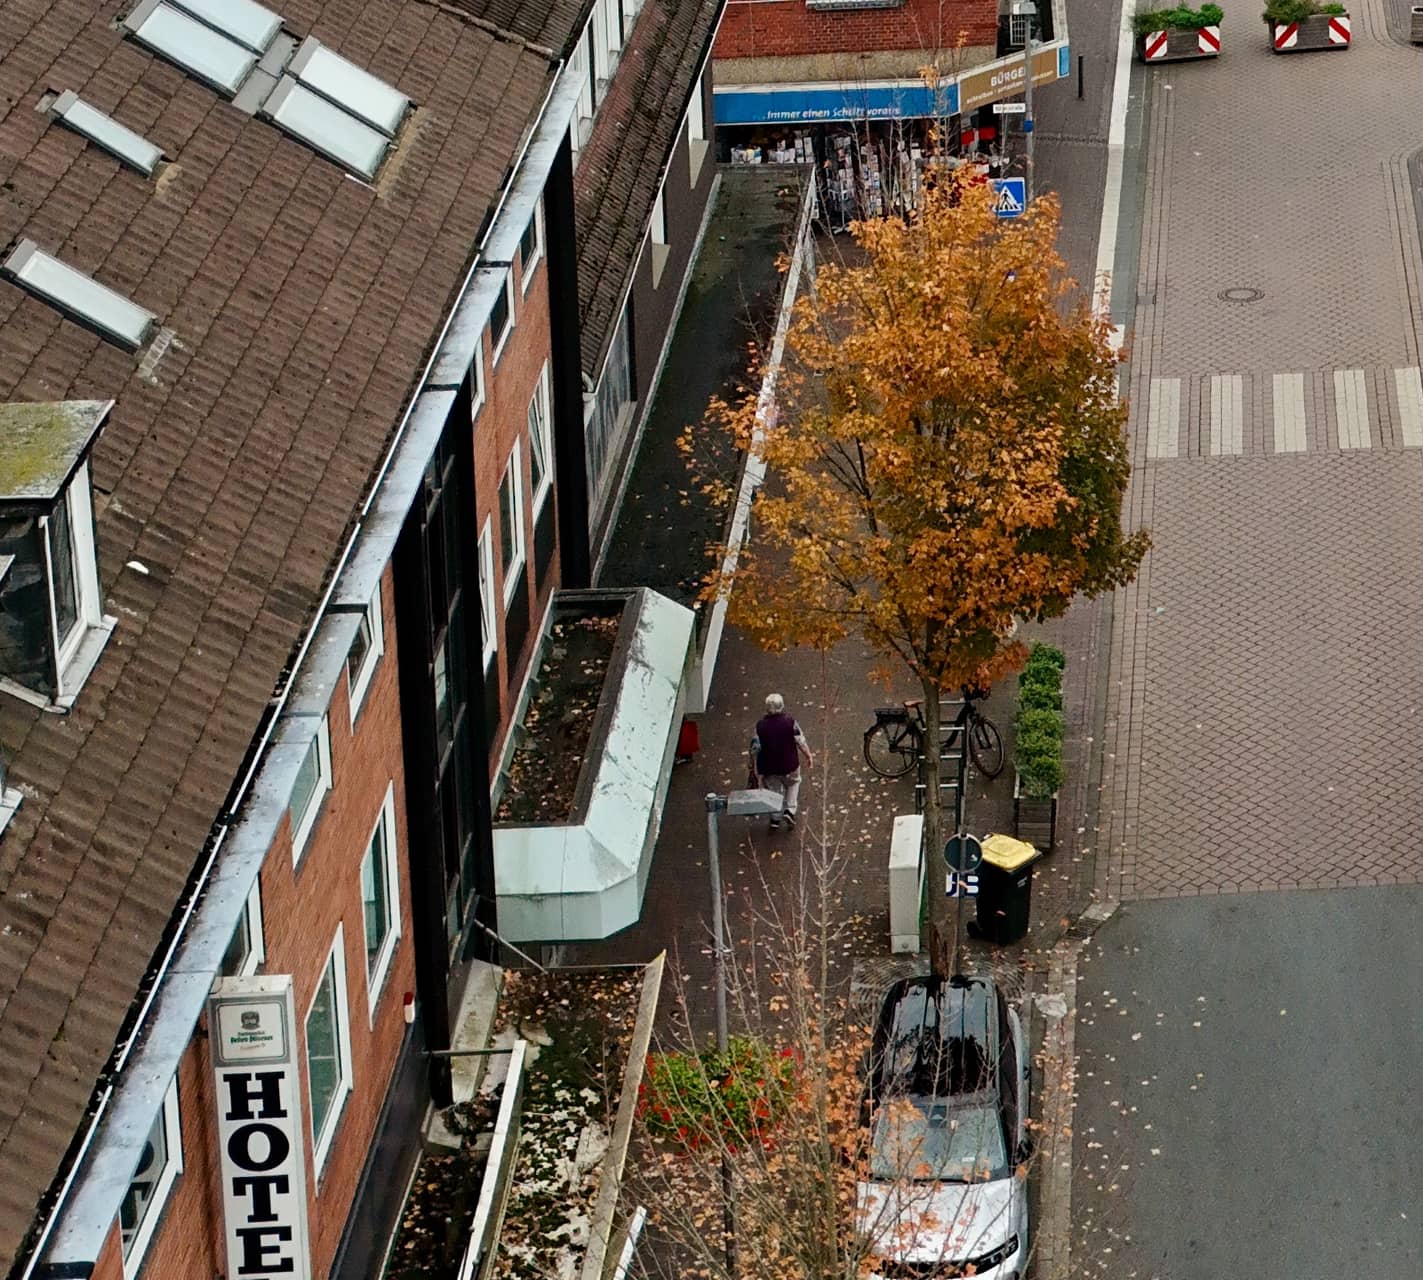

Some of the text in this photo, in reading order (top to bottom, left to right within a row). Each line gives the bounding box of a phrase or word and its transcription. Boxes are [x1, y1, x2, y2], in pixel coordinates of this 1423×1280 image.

[991, 66, 1027, 87] BÜRGE
[802, 108, 830, 118] einen
[223, 1071, 294, 1280] HOTE
